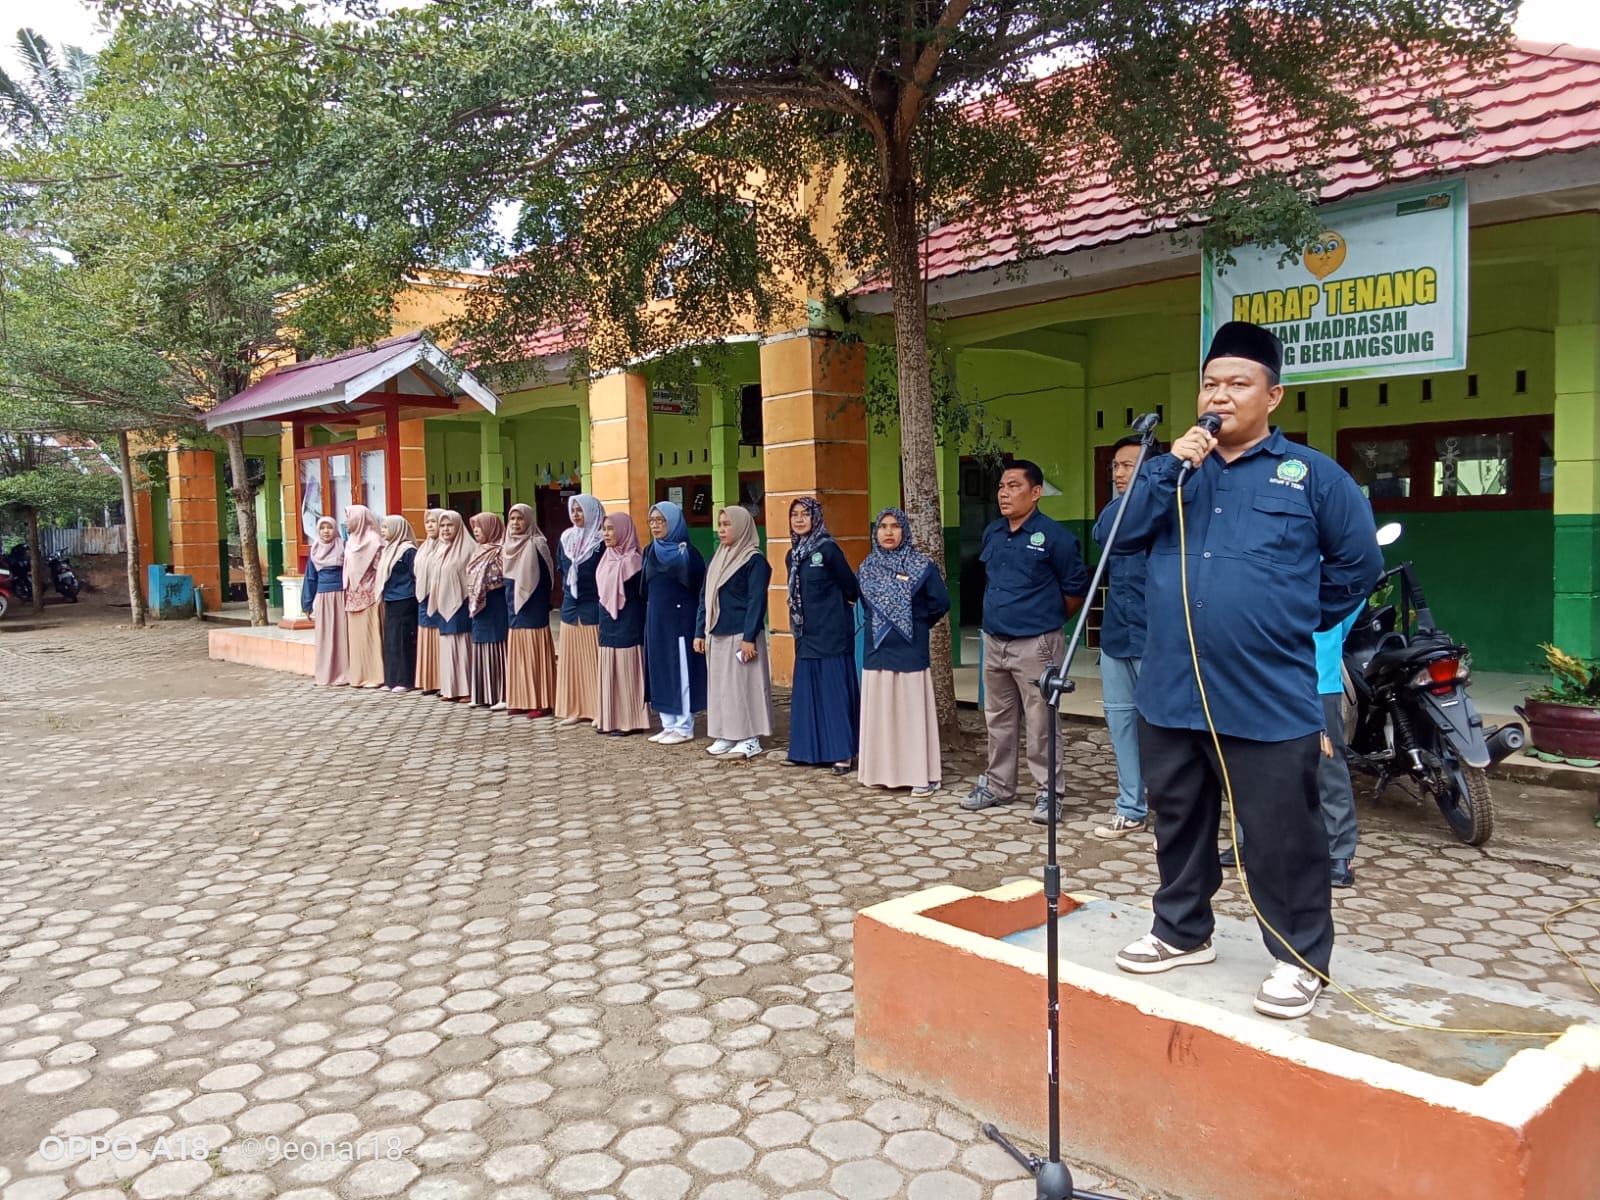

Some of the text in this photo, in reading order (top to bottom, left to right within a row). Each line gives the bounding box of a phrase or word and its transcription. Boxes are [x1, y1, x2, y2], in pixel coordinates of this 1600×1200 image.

[1232, 266, 1437, 325] HARAP TENANG
[1305, 311, 1407, 341] MADRASAH
[1300, 331, 1434, 364] BERLANGSUNG
